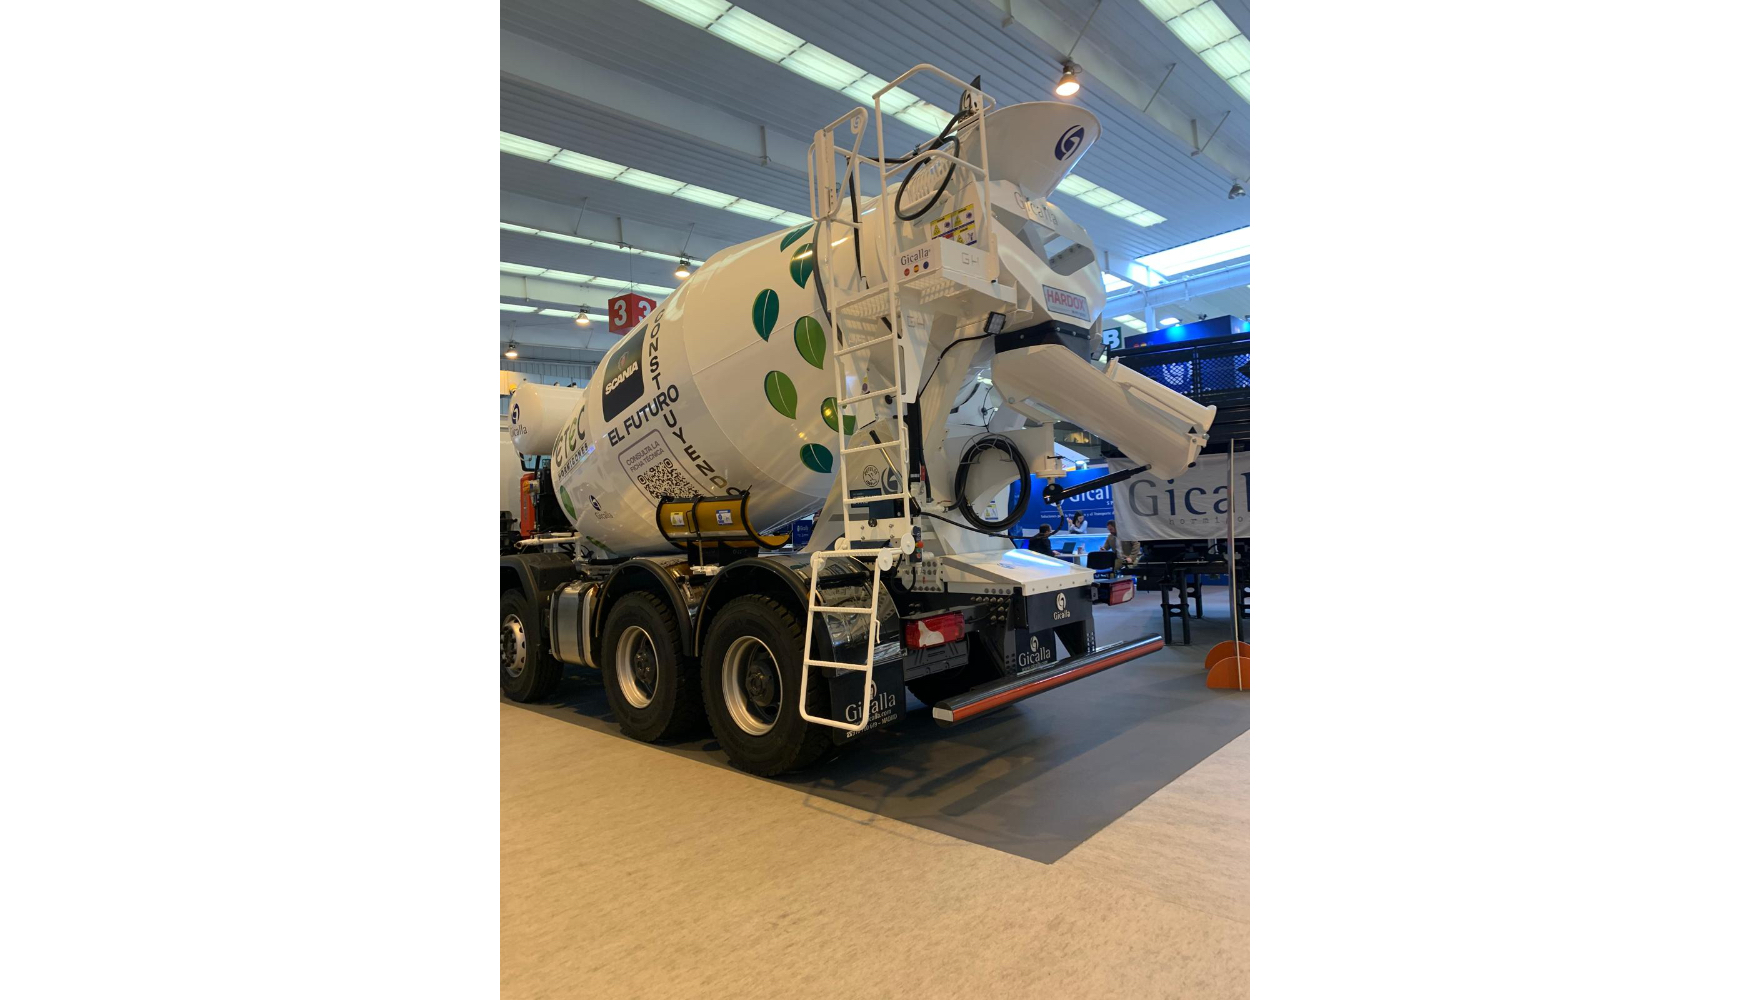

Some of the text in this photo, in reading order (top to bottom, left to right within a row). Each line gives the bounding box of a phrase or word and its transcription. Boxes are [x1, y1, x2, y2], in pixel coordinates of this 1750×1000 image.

[900, 249, 928, 266] Gicalla
[638, 301, 651, 321] 3
[1047, 289, 1085, 312] HARDOX
[614, 299, 627, 326] 3
[605, 361, 639, 395] SCANIA
[607, 384, 680, 447] EL FUTURO
[626, 440, 660, 466] CONSULTA LA
[630, 460, 645, 472] FICHA
[1169, 516, 1243, 525] hormio
[1053, 609, 1071, 620] Gicalla
[1018, 646, 1051, 667] Gicalla
[845, 692, 896, 722] Gialla
